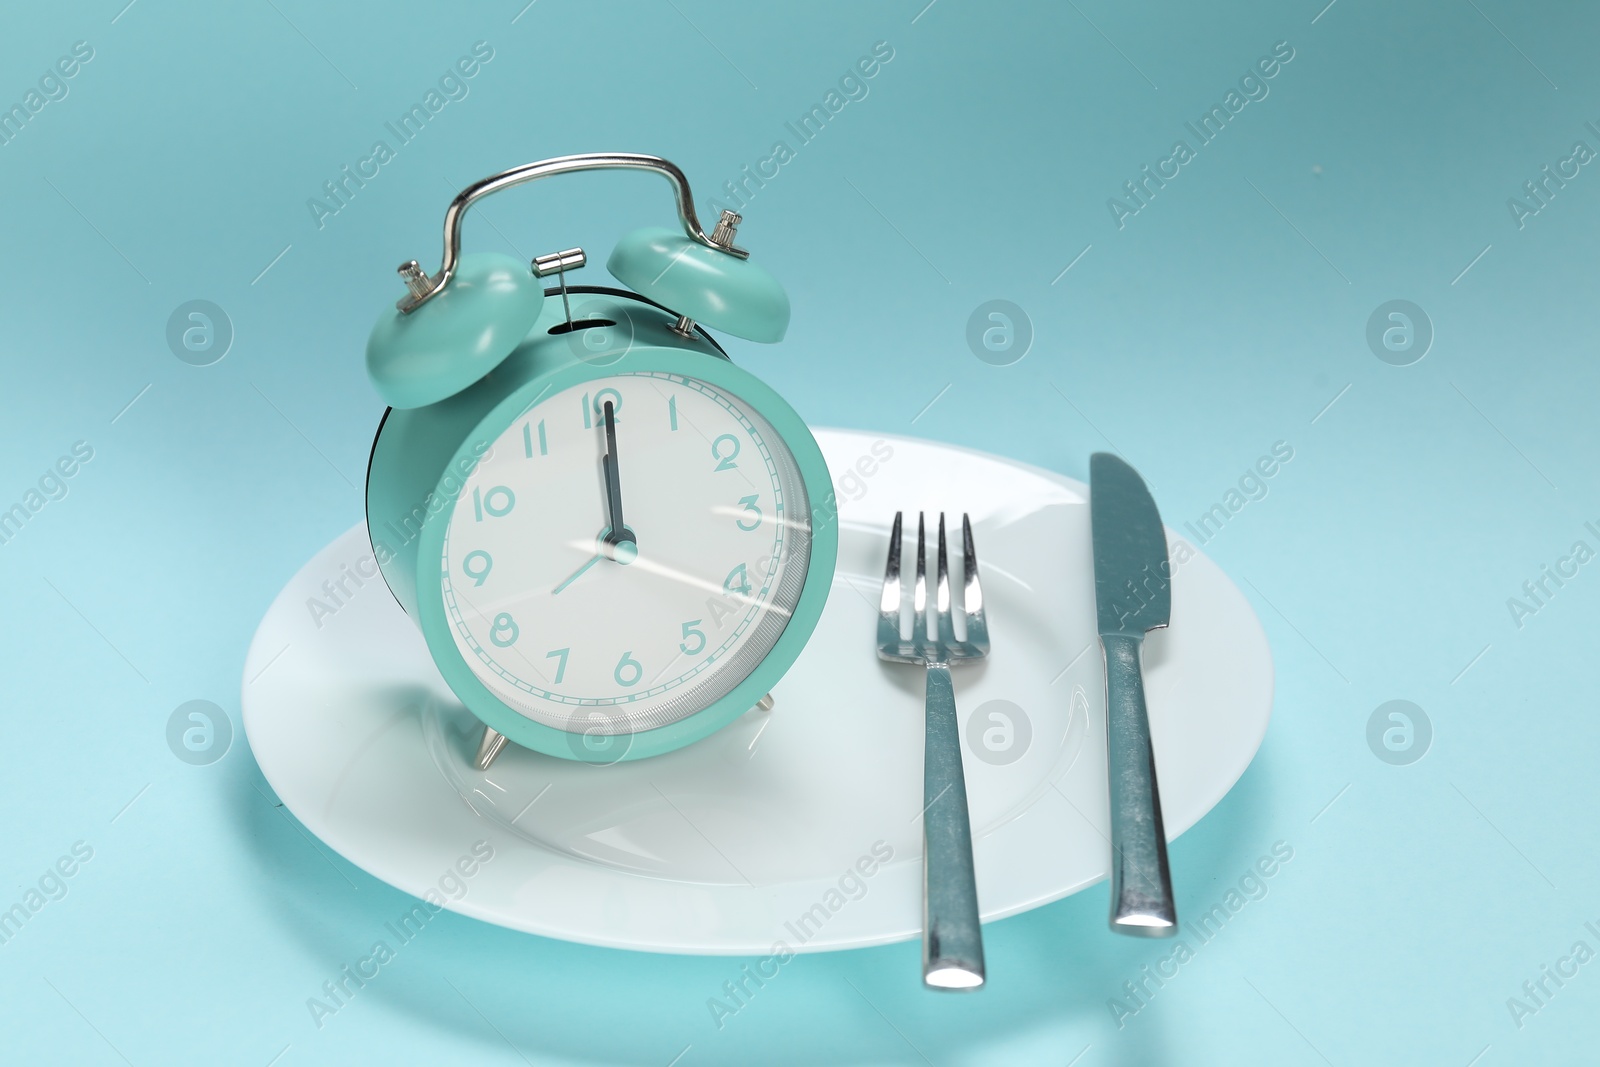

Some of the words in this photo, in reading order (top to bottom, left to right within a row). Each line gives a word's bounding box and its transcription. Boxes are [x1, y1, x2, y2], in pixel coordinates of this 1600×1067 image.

[582, 388, 622, 429] 12
[669, 394, 678, 431] 1
[522, 419, 548, 458] 11
[711, 434, 740, 472] 2
[473, 485, 516, 522] 10
[736, 494, 763, 532] 3
[462, 550, 493, 587] 9
[723, 563, 752, 598] 4
[490, 612, 519, 648] 8
[679, 619, 706, 655] 5
[546, 648, 570, 685] 7
[614, 651, 643, 687] 6
